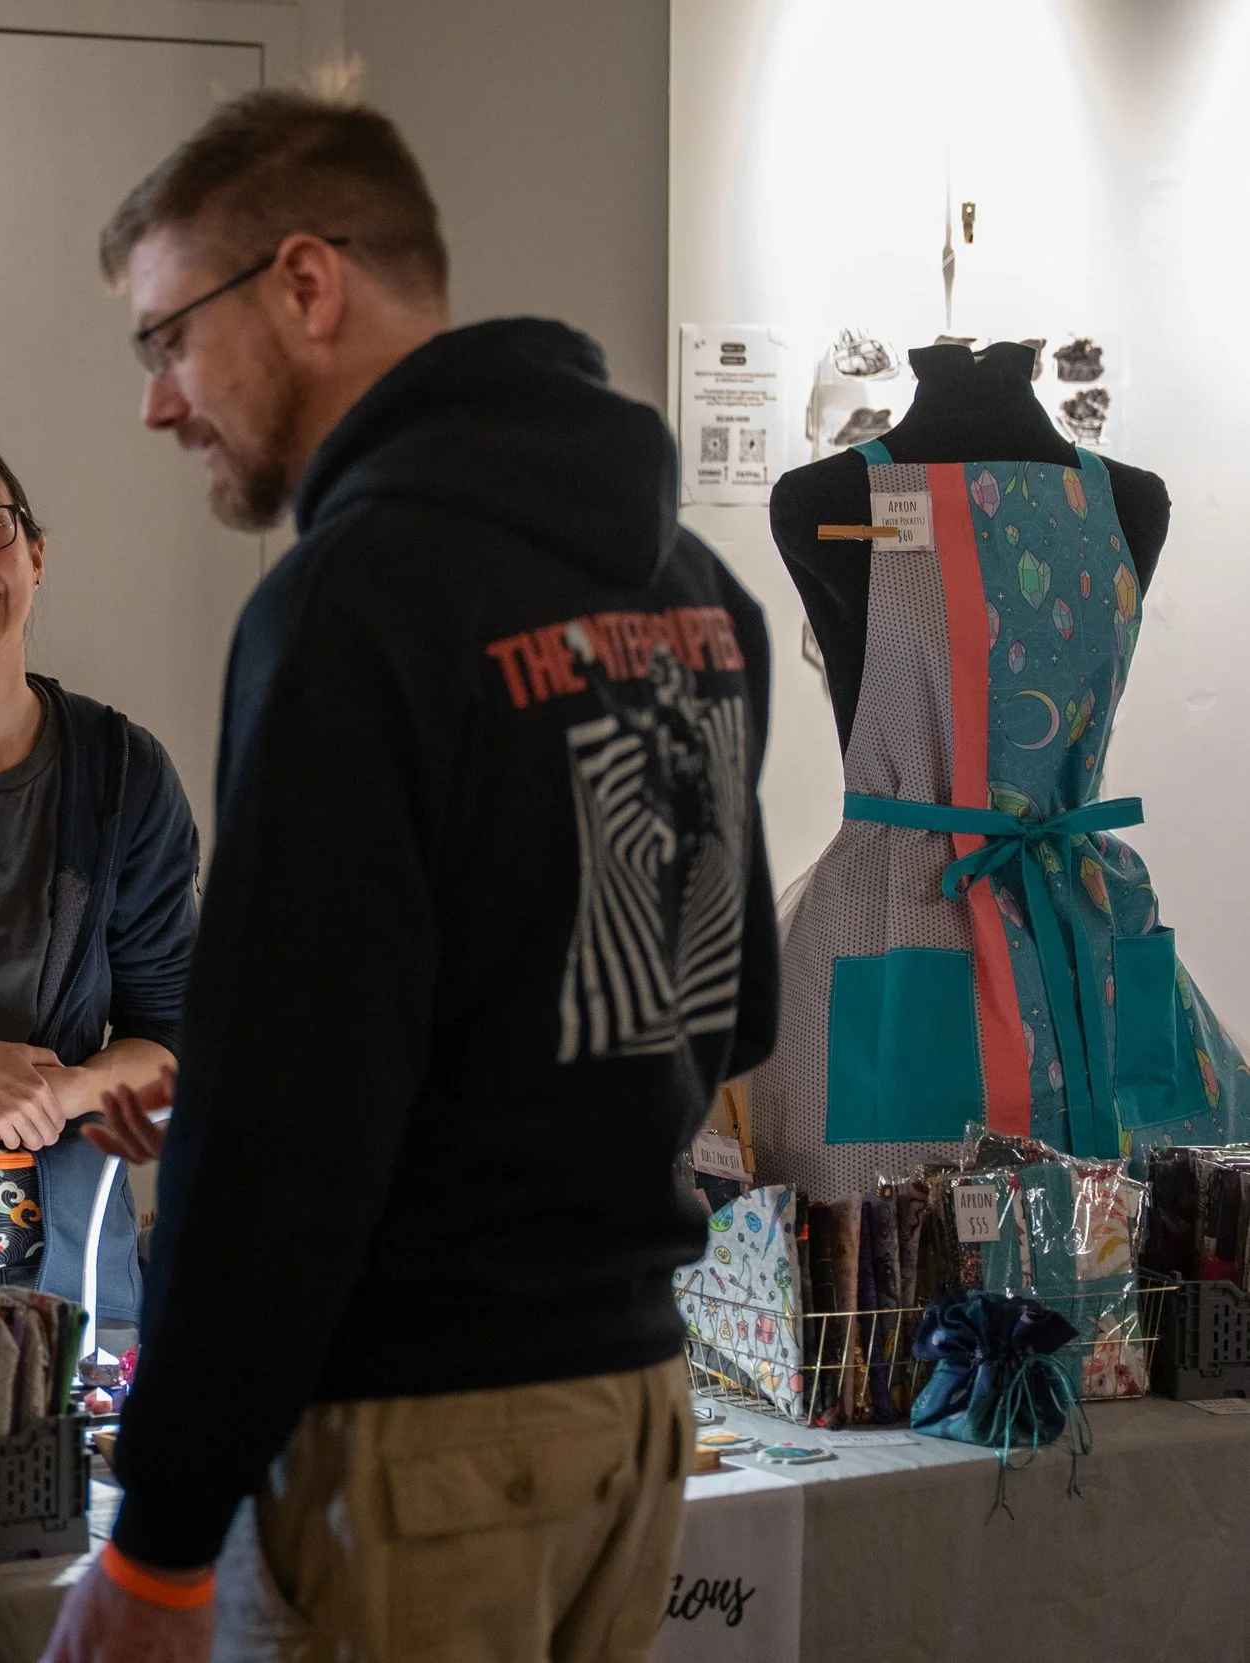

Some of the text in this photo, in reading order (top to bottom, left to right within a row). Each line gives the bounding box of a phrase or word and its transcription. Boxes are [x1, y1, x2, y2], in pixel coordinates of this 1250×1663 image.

[888, 501, 917, 513] APRON
[485, 621, 588, 711] THE
[960, 1192, 992, 1208] APRON
[969, 1216, 989, 1236] $55
[666, 1574, 756, 1627] ions
